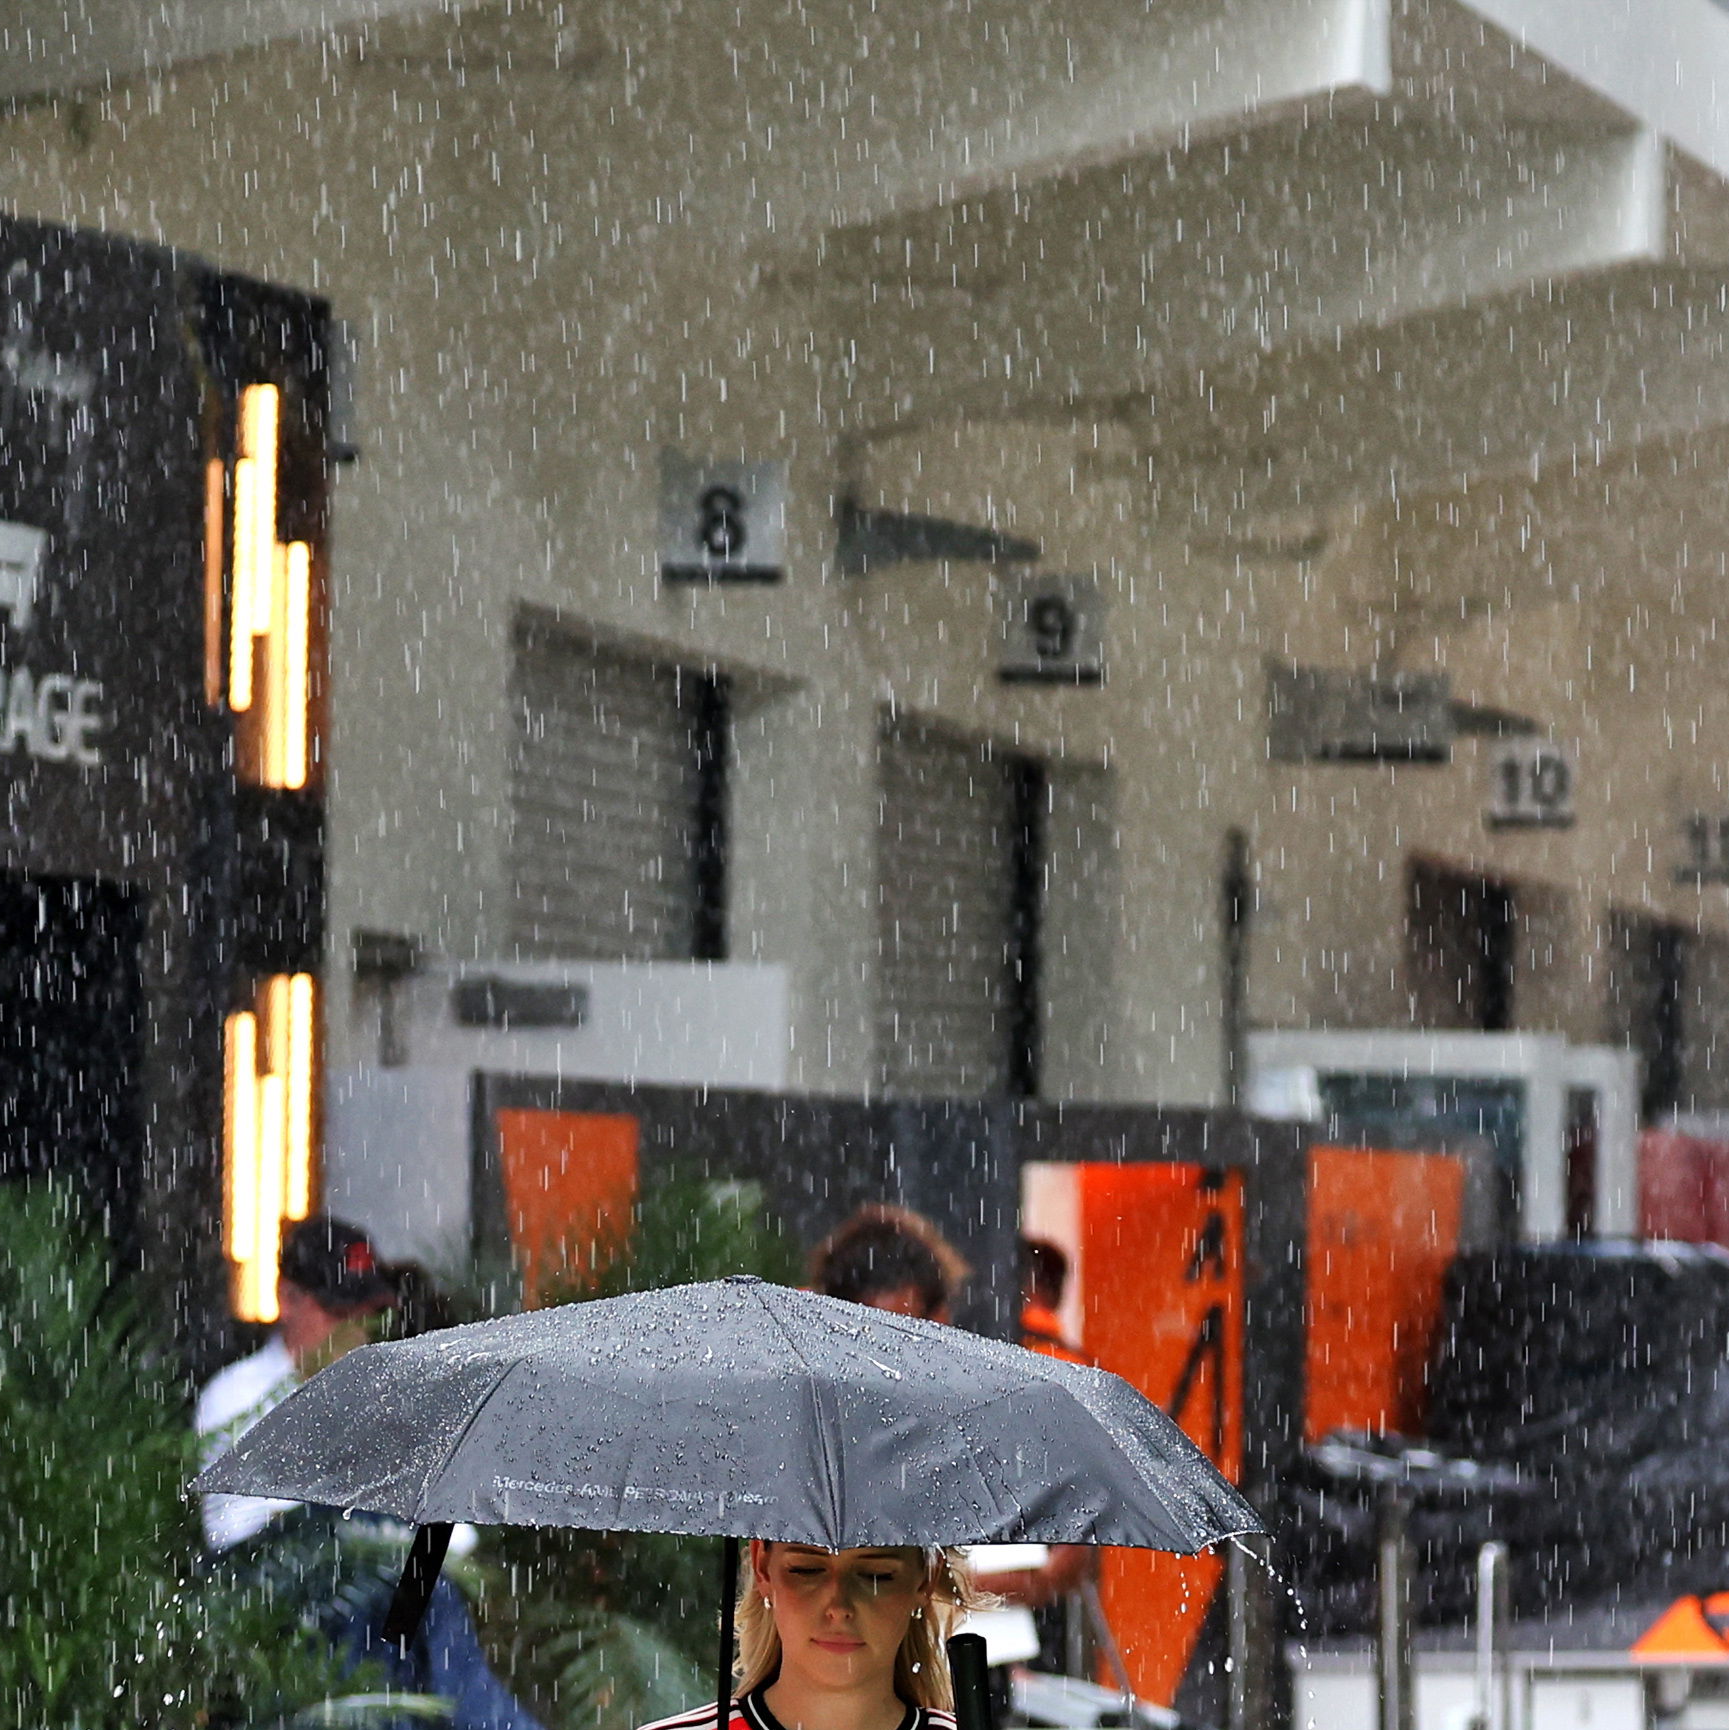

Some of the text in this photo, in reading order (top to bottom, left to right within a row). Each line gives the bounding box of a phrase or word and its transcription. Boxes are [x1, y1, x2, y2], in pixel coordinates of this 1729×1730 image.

[698, 484, 747, 557] 8
[1031, 595, 1075, 658] 9
[1499, 755, 1569, 808] 10
